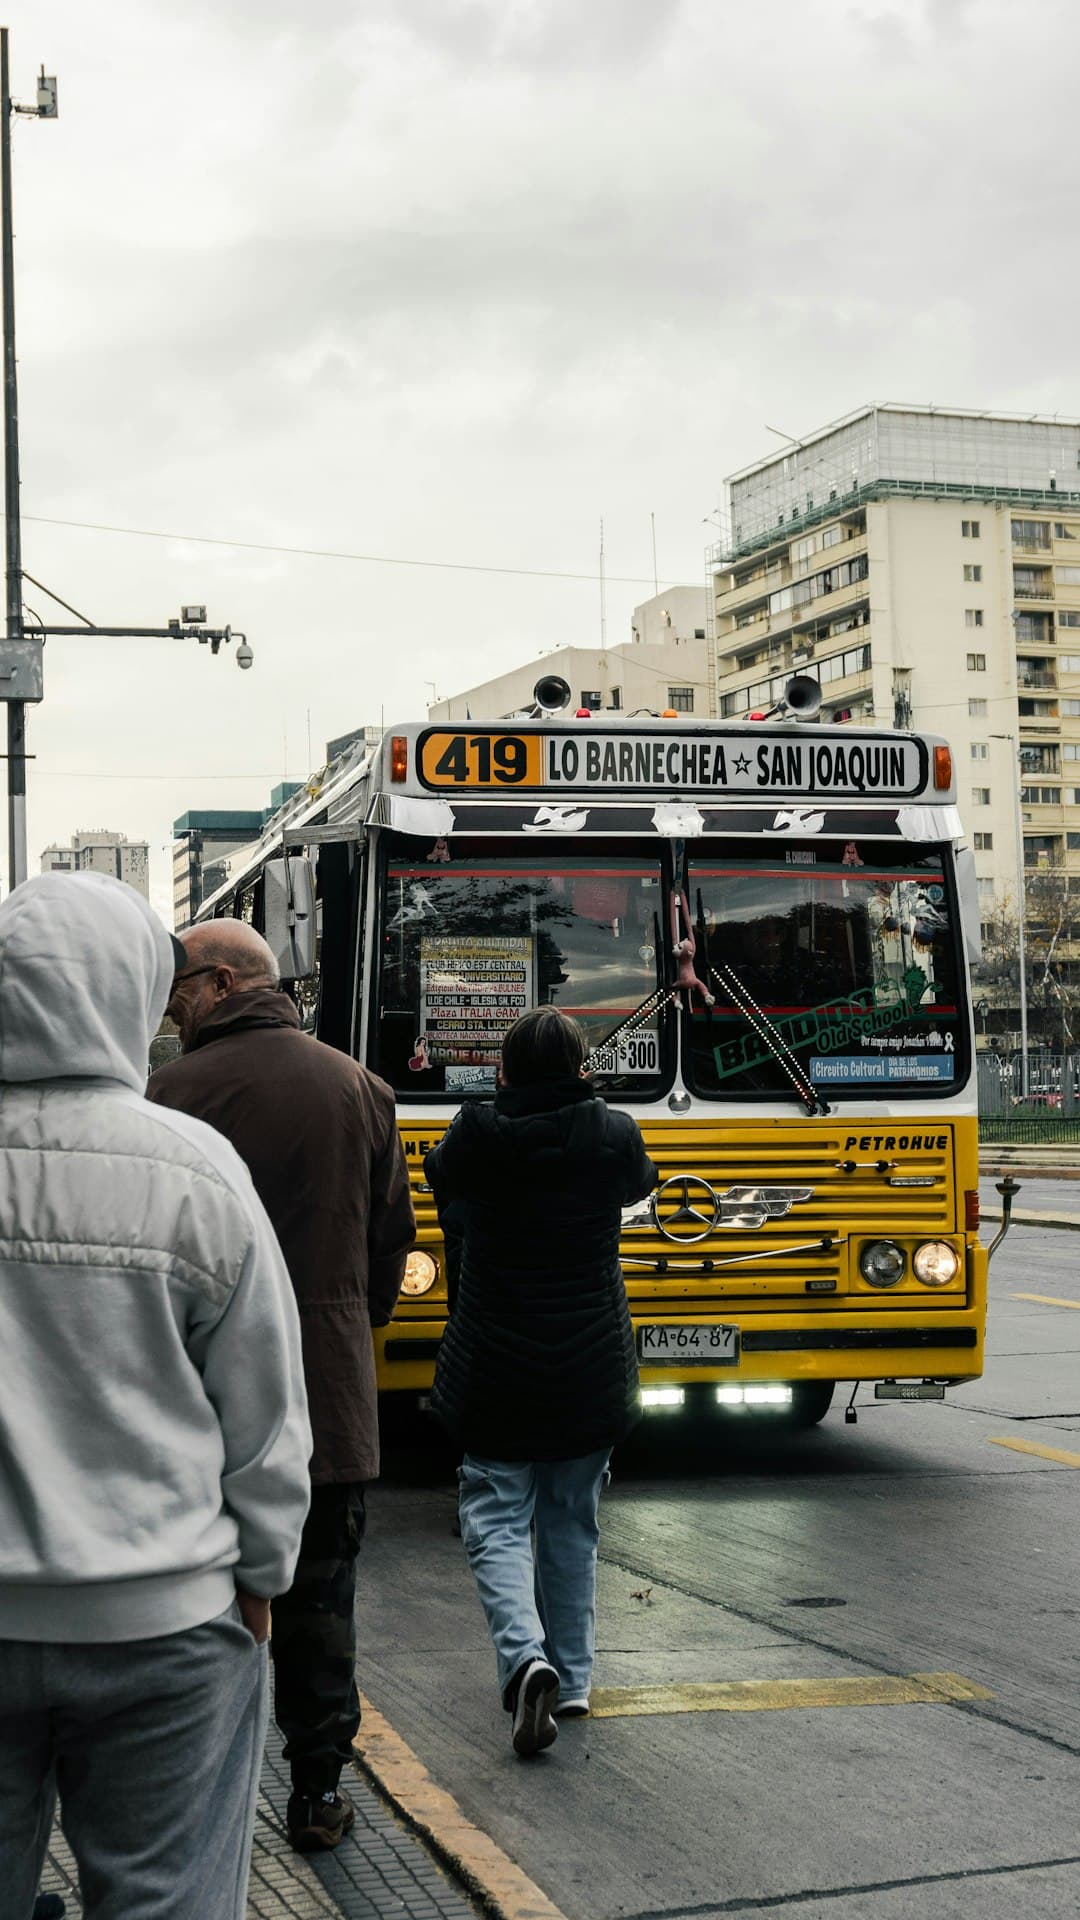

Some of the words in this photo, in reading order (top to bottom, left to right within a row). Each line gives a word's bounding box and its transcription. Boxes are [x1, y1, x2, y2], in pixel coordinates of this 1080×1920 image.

[435, 736, 527, 783] 419
[549, 739, 579, 781] LO
[586, 740, 728, 785] BARNECHEA
[757, 745, 801, 786] SAN
[809, 746, 905, 792] JOAQUIN
[445, 996, 465, 1005] CHILE
[471, 996, 497, 1005] IGLESIA
[431, 1007, 456, 1017] Plaza
[460, 1007, 492, 1018] ITALIA
[495, 1007, 520, 1018] GAM
[437, 1020, 466, 1030] CERRO
[467, 1020, 486, 1030] STA.
[817, 1030, 848, 1051] Old
[850, 1002, 908, 1039] School
[815, 1062, 848, 1077] Circuito
[850, 1060, 885, 1077] Cultural
[888, 1066, 939, 1077] PATRIMONIOS
[844, 1136, 948, 1151] PETROHUE
